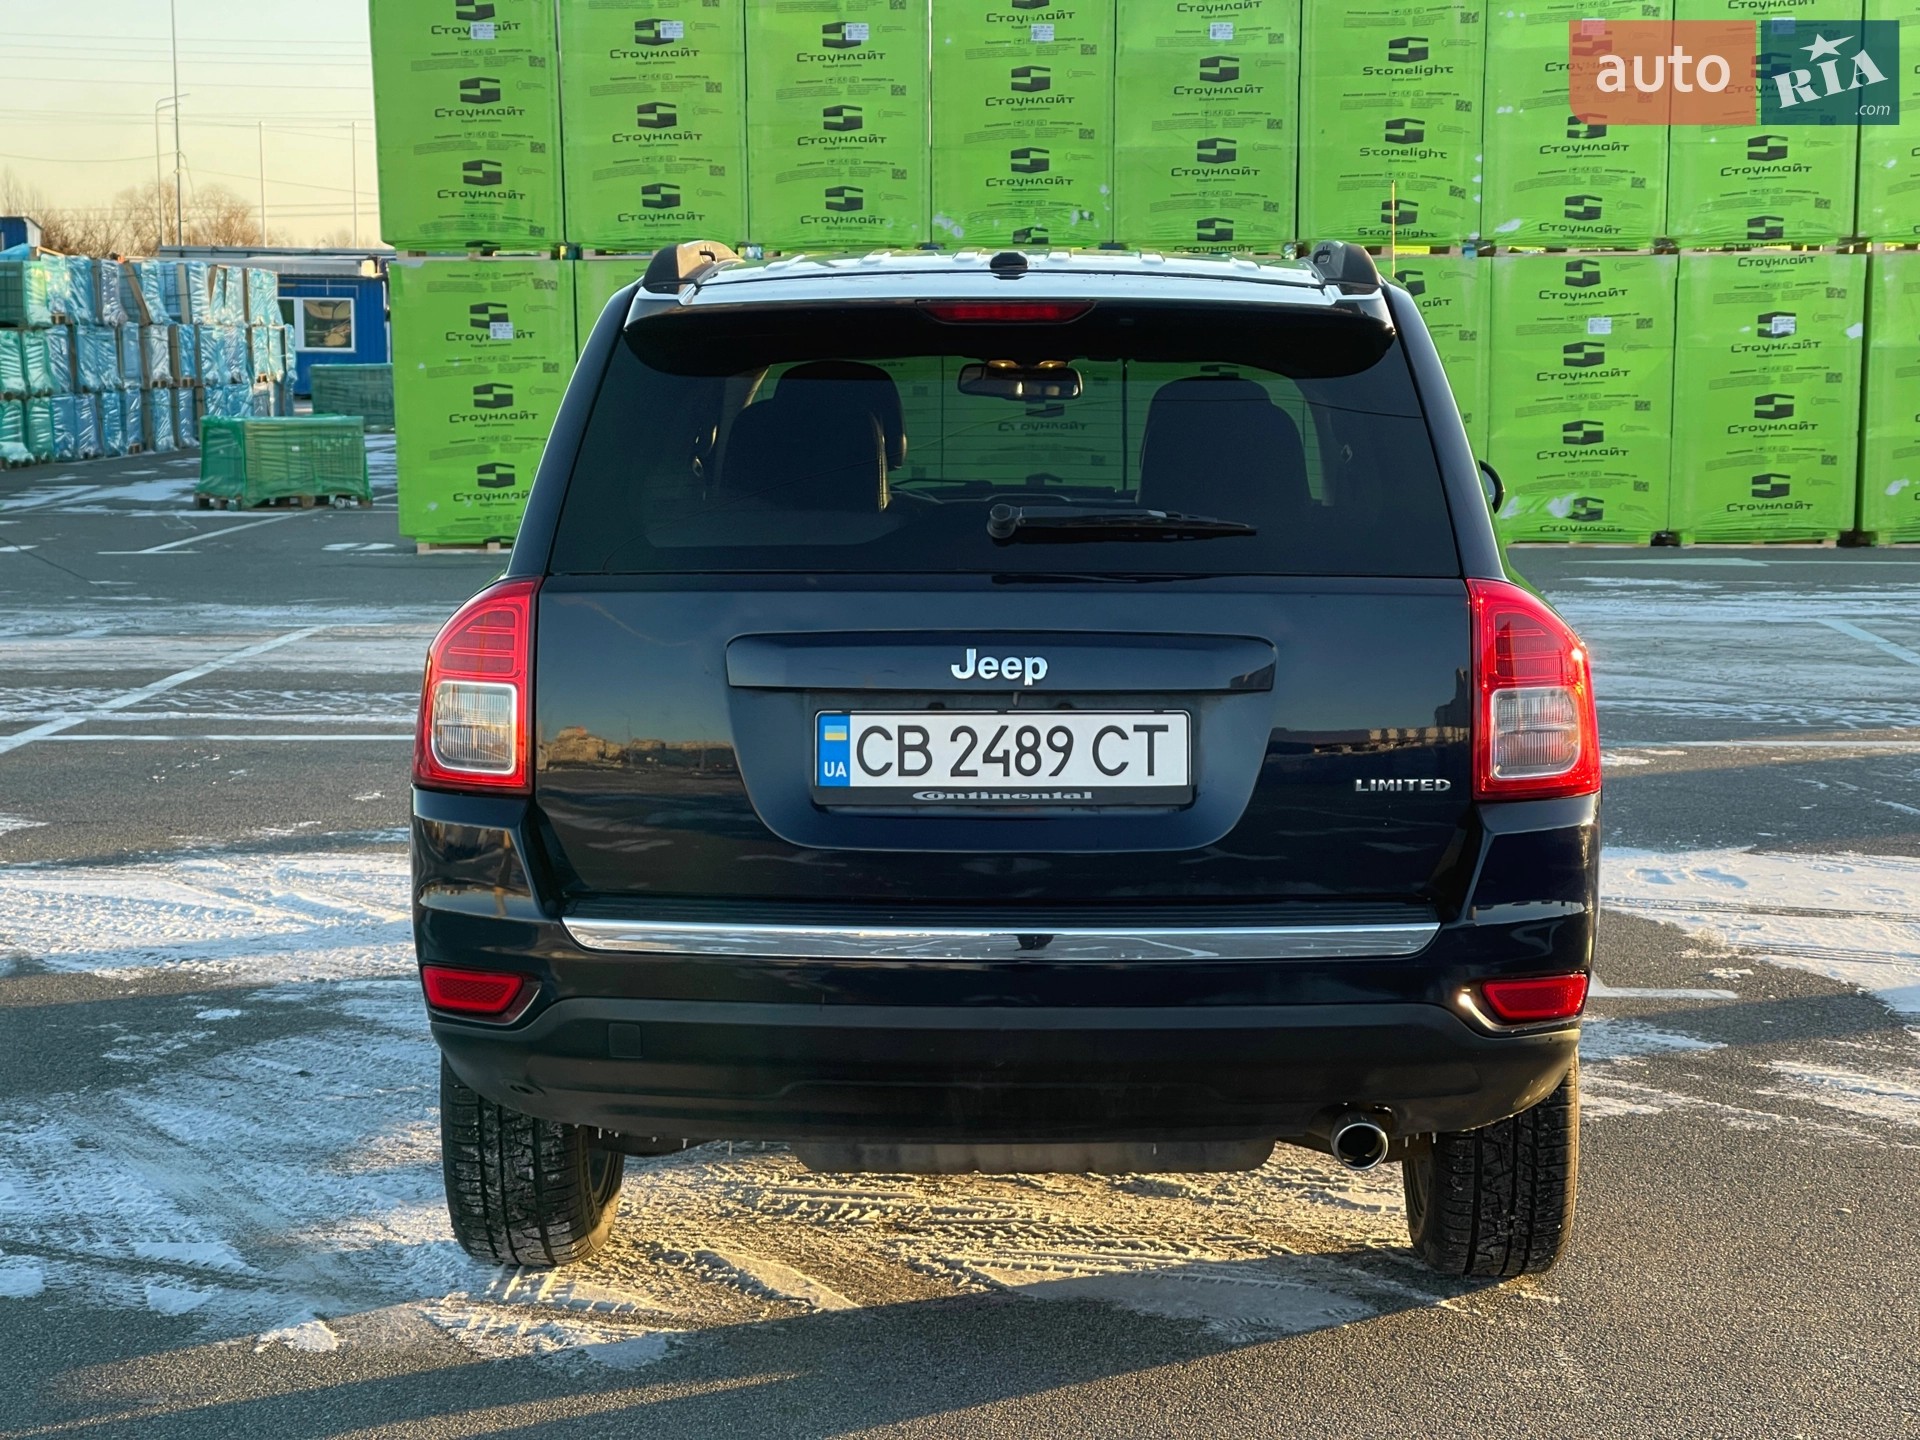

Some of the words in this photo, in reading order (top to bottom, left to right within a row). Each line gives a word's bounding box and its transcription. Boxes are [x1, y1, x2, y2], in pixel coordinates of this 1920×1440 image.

[1177, 0, 1263, 14] Стоунлайт
[431, 21, 521, 35] Стоуайт
[610, 48, 700, 60] Стоунлайт
[797, 51, 886, 63] Стоунлайт
[1362, 65, 1454, 77] Stonelight
[1173, 84, 1264, 96] Стоунлайт
[985, 95, 1075, 107] Стоунлайт
[435, 106, 526, 118] Стоунлайт
[613, 131, 703, 143] Стоунлайт
[798, 134, 887, 146] Стоунлайт
[1359, 148, 1448, 159] Stonelight
[1540, 142, 1630, 155] Стоунлайт
[1171, 167, 1261, 178] Стоунлайт
[1720, 164, 1813, 177] Стоунлайт
[986, 176, 1074, 187] Стоунлайт
[437, 190, 526, 201] Стоунлайт
[617, 212, 706, 223] Стоунлайт
[801, 215, 886, 226] Стоунлайт
[1539, 223, 1622, 235] Стоунлайт
[1738, 254, 1816, 268] Стоунлайт
[1539, 288, 1628, 301] Стоунлайт
[1537, 369, 1631, 381] Стоунлайт
[449, 411, 539, 423] Стоунлайт
[1727, 421, 1819, 434] Стоунлайт
[1537, 447, 1630, 460] Стоунлайт
[453, 490, 530, 502] Стоунлай
[1726, 501, 1814, 512] Стоунлайт
[951, 648, 1048, 686] Jeep
[856, 725, 933, 777] CB
[950, 725, 1074, 777] 2489
[1092, 724, 1169, 777] CT
[824, 762, 847, 778] UA
[1355, 779, 1452, 791] LIMITED
[912, 791, 1094, 801] Continental
